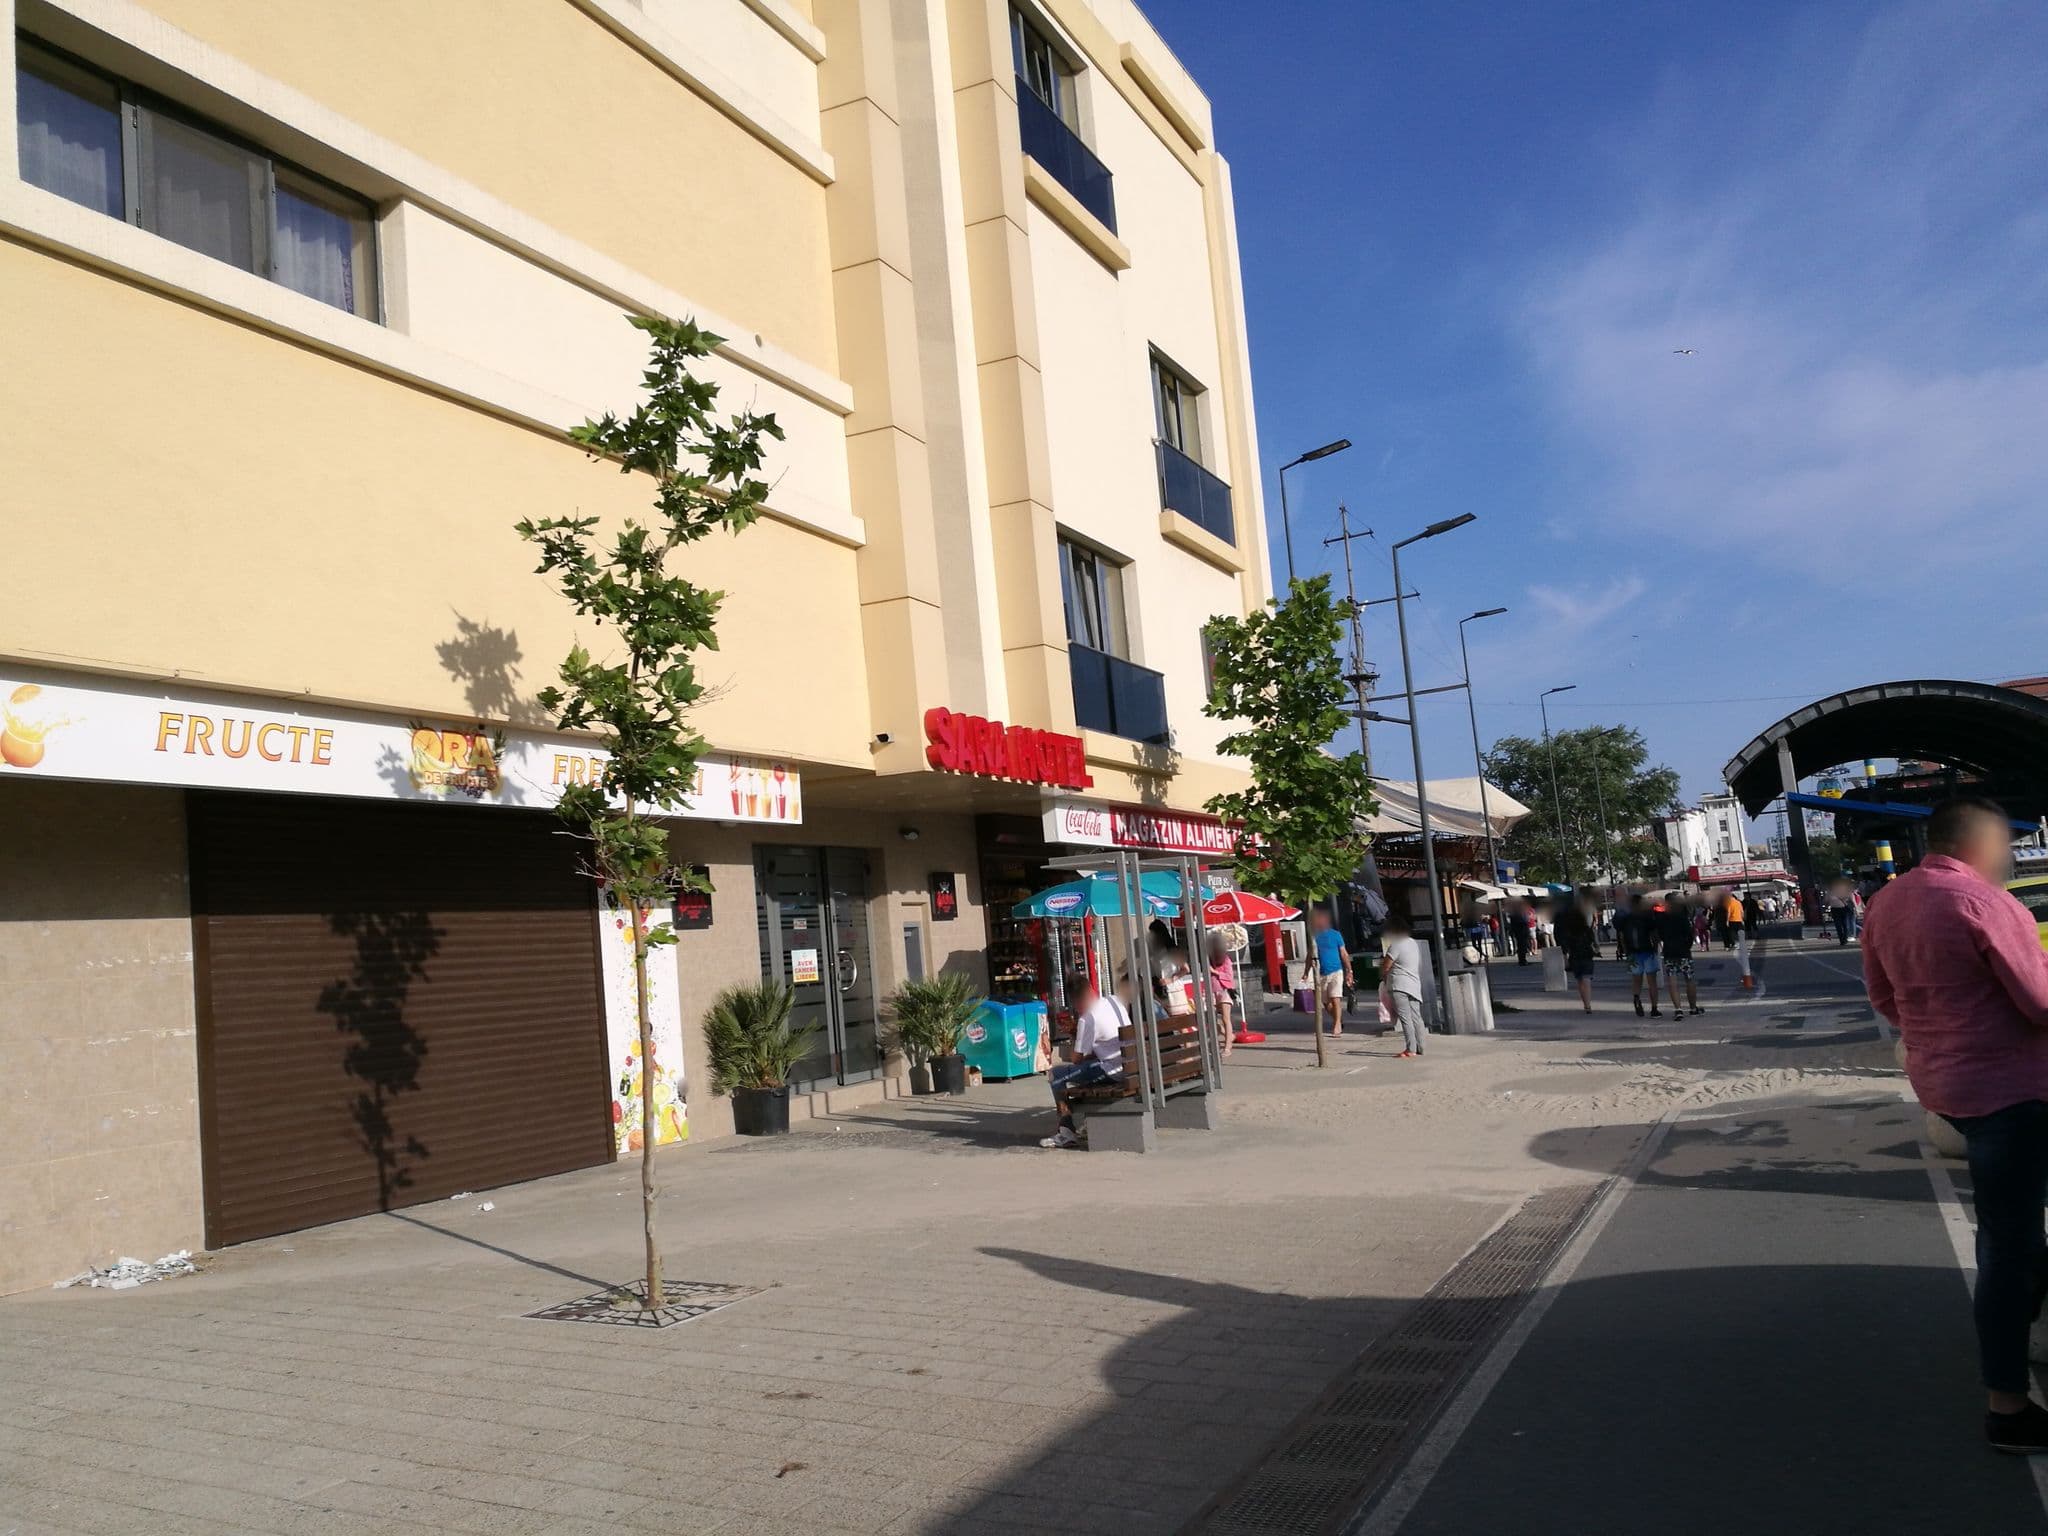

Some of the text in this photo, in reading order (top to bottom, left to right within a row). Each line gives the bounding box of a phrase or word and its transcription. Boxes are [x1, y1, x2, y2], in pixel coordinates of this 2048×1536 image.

[154, 710, 335, 766] FRUCTE
[411, 726, 498, 771] ORA
[924, 706, 1094, 788] SARA HOTEL
[424, 770, 489, 788] DE FRUCTE
[1115, 811, 1183, 846] MAGAZIN
